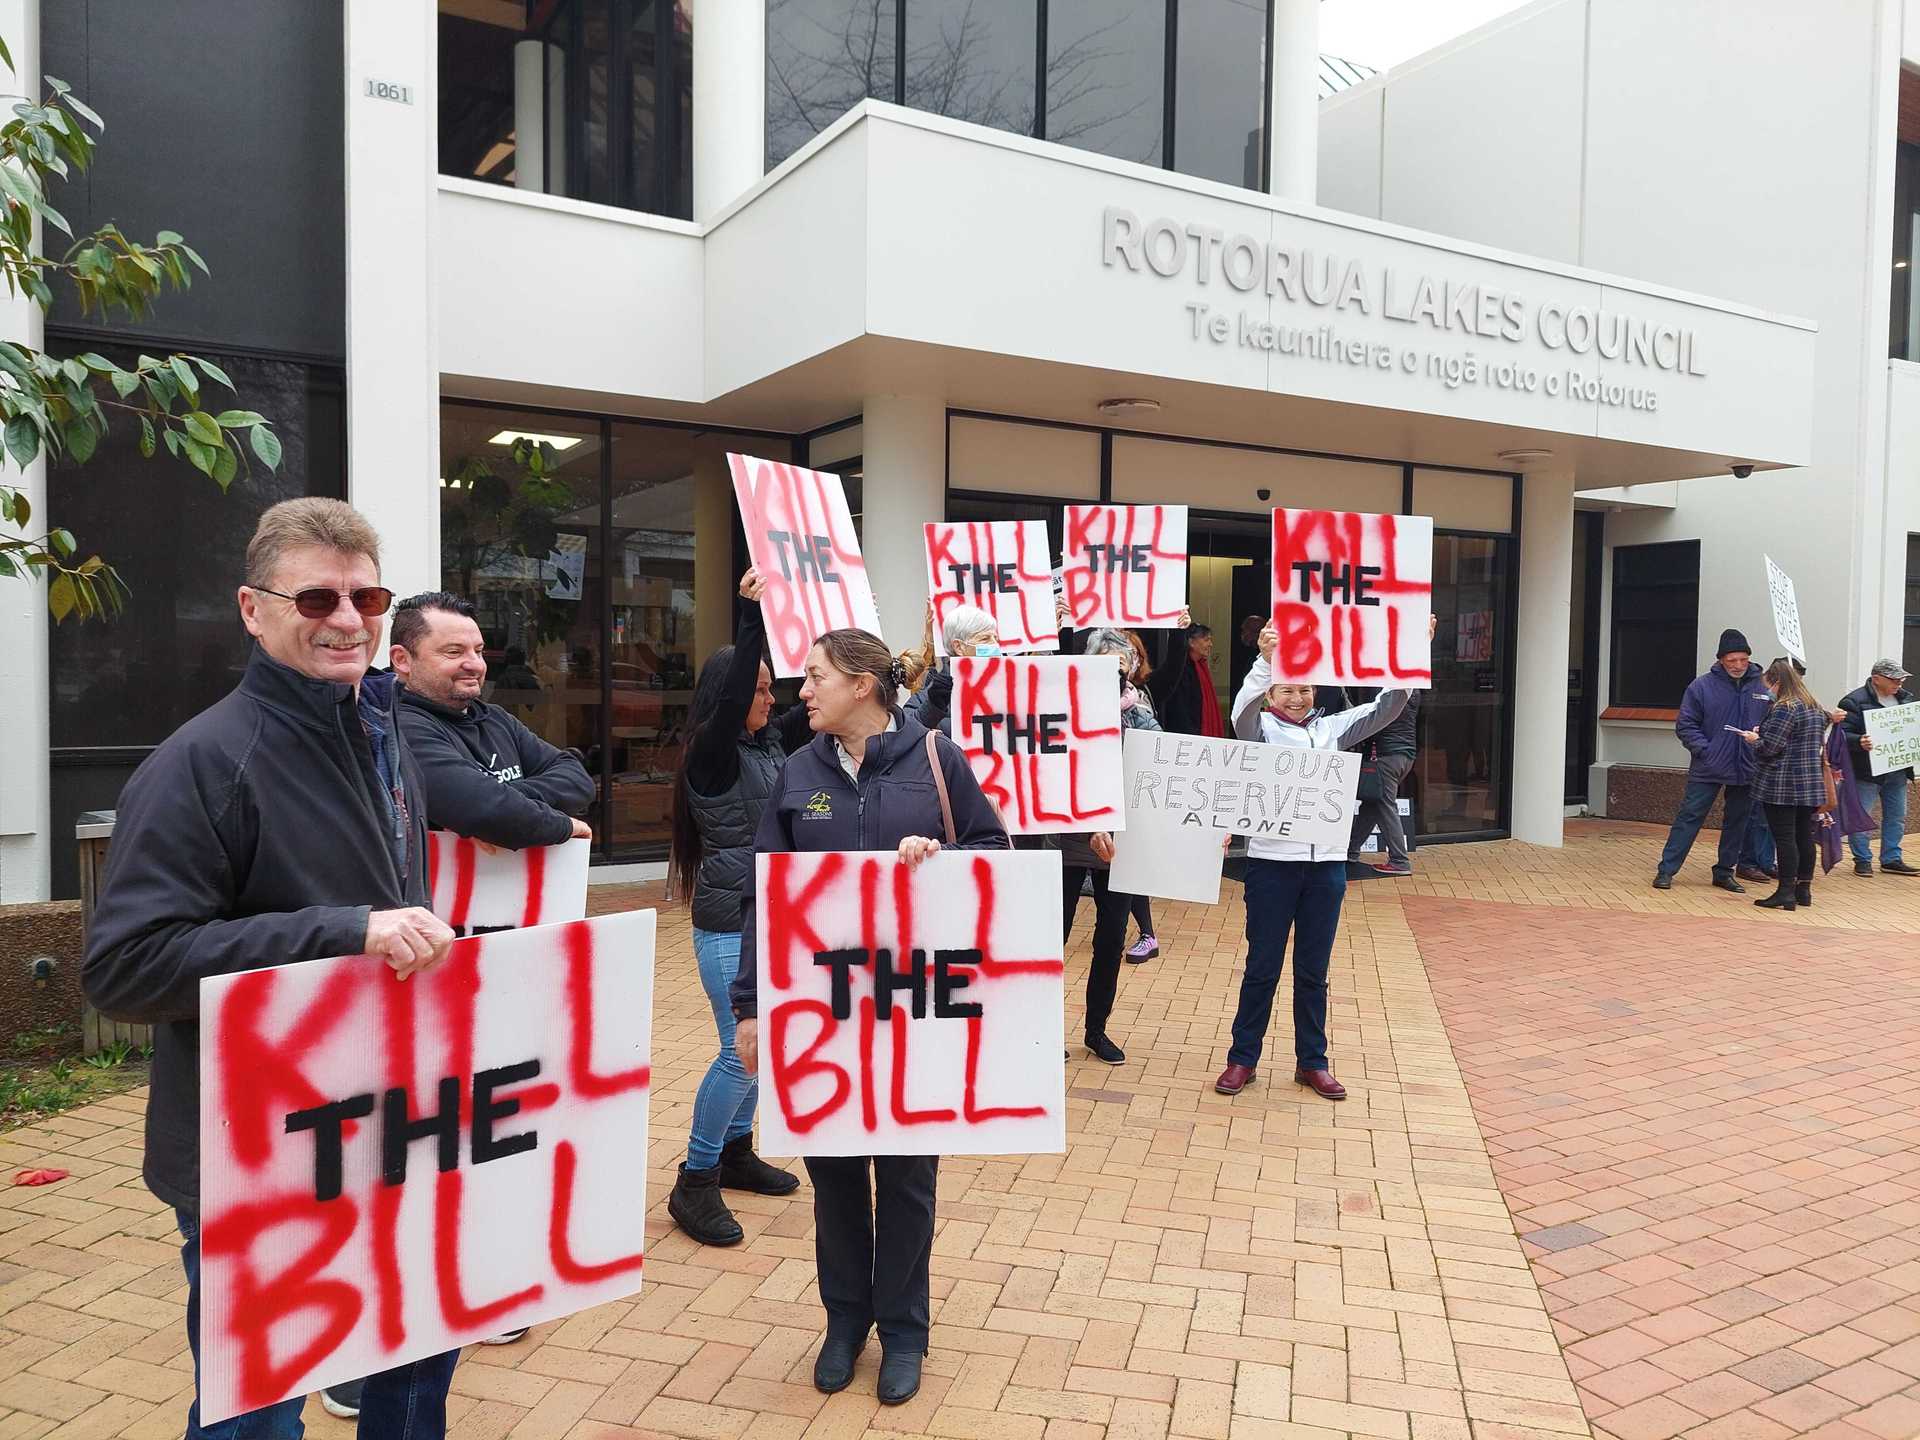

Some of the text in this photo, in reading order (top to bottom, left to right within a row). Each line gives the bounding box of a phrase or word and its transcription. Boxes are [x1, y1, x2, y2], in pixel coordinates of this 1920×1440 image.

[368, 80, 408, 102] 1061
[1103, 207, 1706, 377] ROTORUA LAKES COUNCIL
[1186, 302, 1658, 412] Te kaunihera o ngā roto o Rotorua
[732, 455, 864, 570] KILL
[1069, 505, 1186, 559] KILL
[767, 530, 840, 583] THE
[925, 521, 1051, 587] KILL
[948, 563, 1018, 594] THE
[1084, 544, 1152, 573] THE
[1274, 508, 1431, 593] KILL
[1292, 561, 1381, 606] THE
[1064, 563, 1182, 625] BILL
[1274, 602, 1431, 679] BILL
[958, 658, 1119, 738] KILL
[972, 713, 1067, 755] THE
[1154, 737, 1345, 784] LEAVE OUR
[1875, 739, 1906, 756] SAVE
[964, 748, 1113, 830] BILL
[1131, 771, 1343, 823] RESERVES
[1181, 812, 1292, 836] ALONE
[767, 853, 1063, 990] KILL
[814, 948, 983, 1020] THE
[218, 920, 650, 1173] KILL
[769, 996, 1048, 1134] BILL
[284, 1059, 541, 1201] THE
[200, 1142, 643, 1410] BILL
